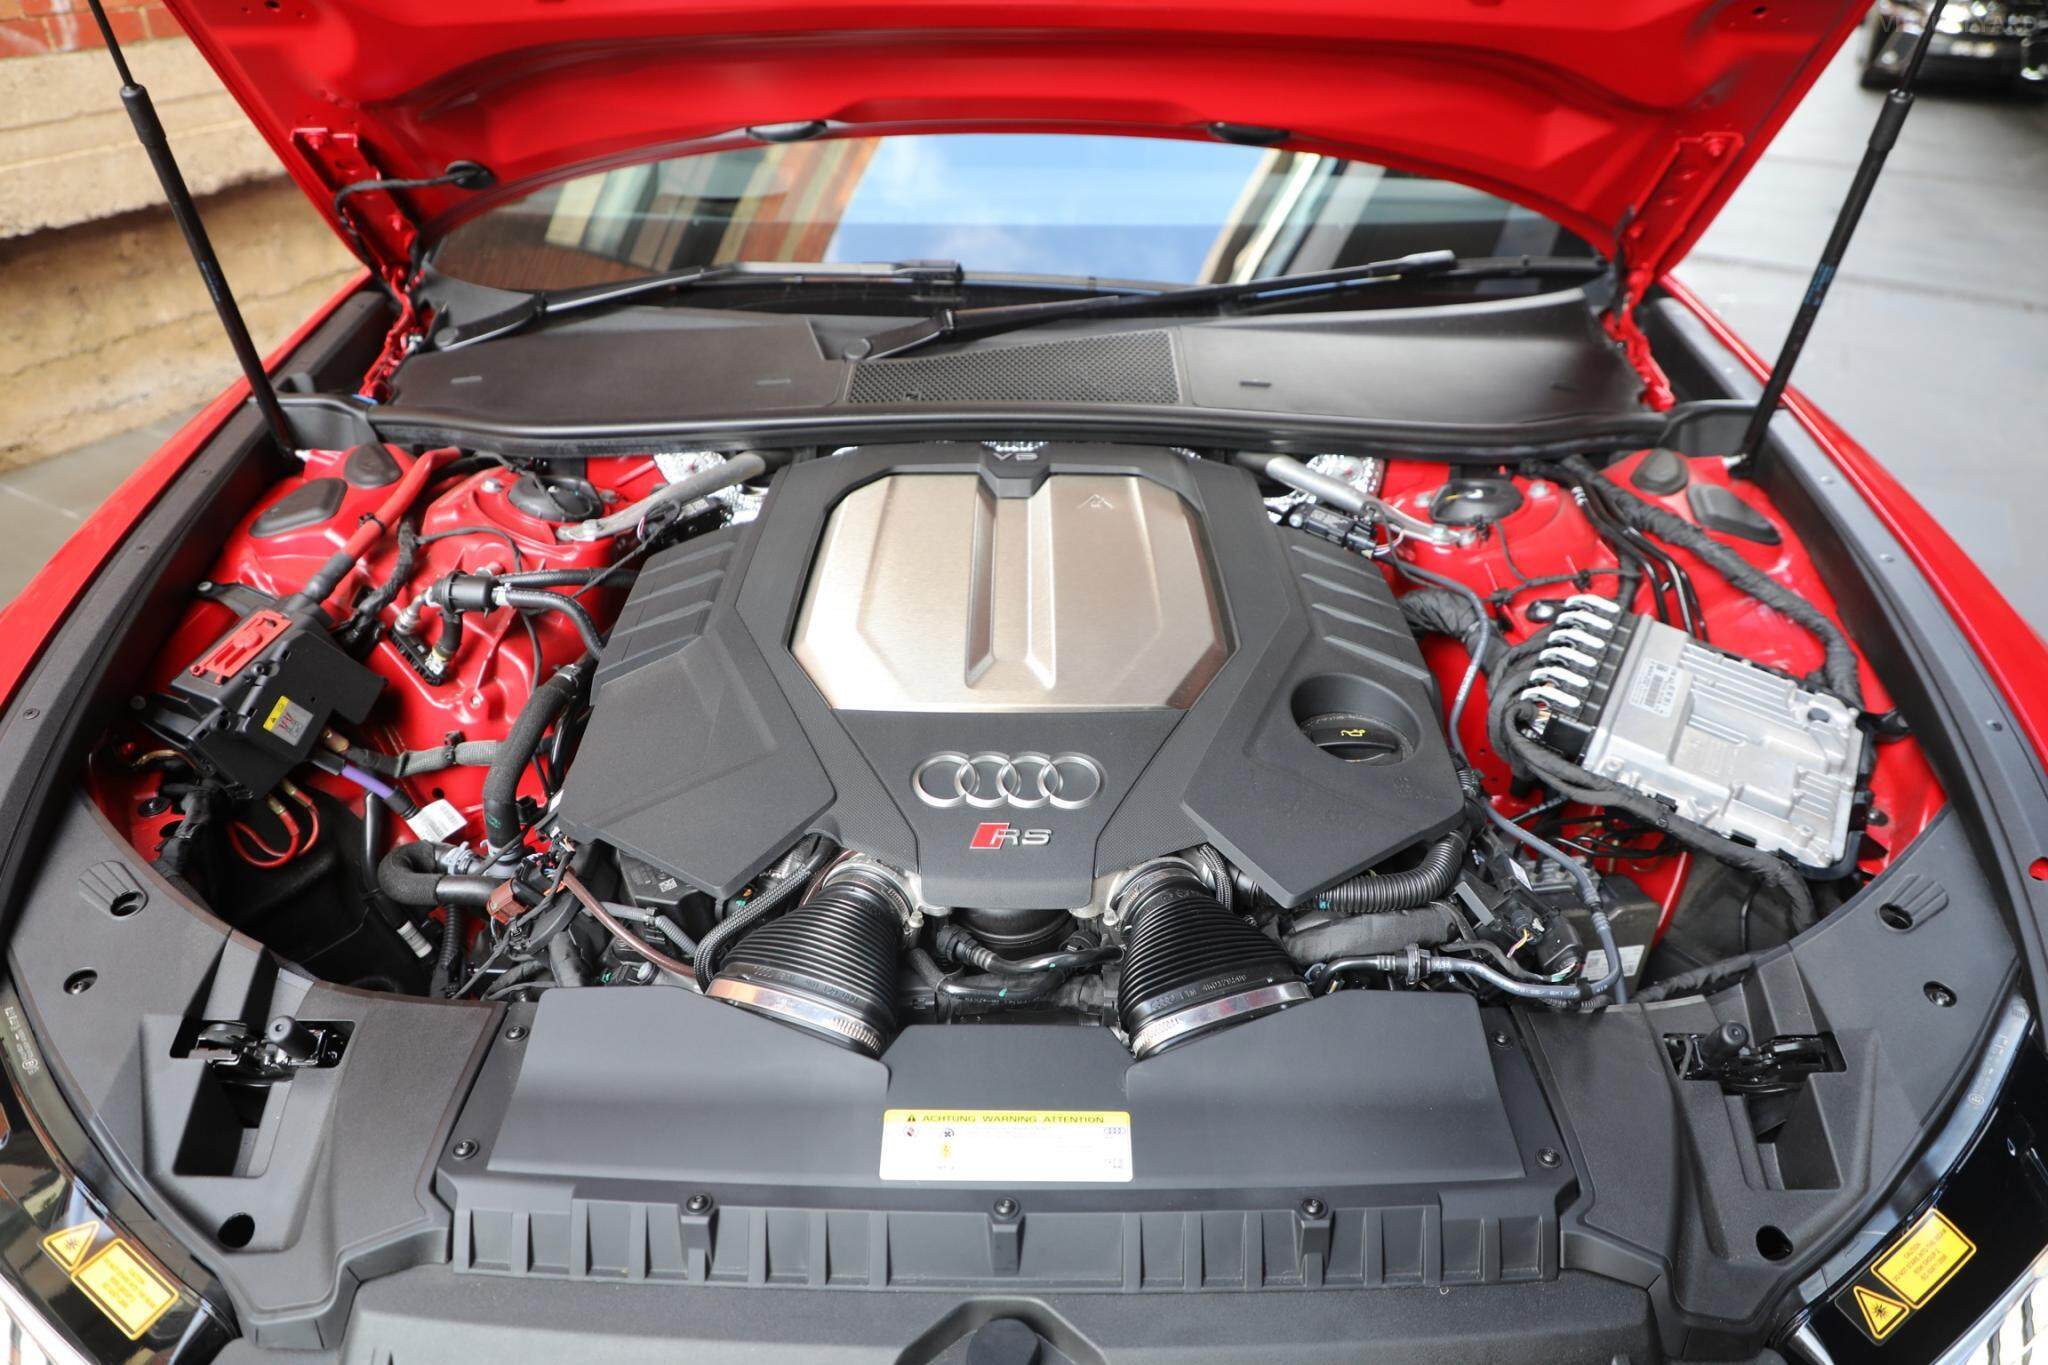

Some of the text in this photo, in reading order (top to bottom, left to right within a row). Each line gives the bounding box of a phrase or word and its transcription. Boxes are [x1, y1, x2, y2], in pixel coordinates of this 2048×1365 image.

[989, 827, 1053, 846] RS
[922, 1115, 1105, 1124] ACHTUNG WARNING ATTENTION
